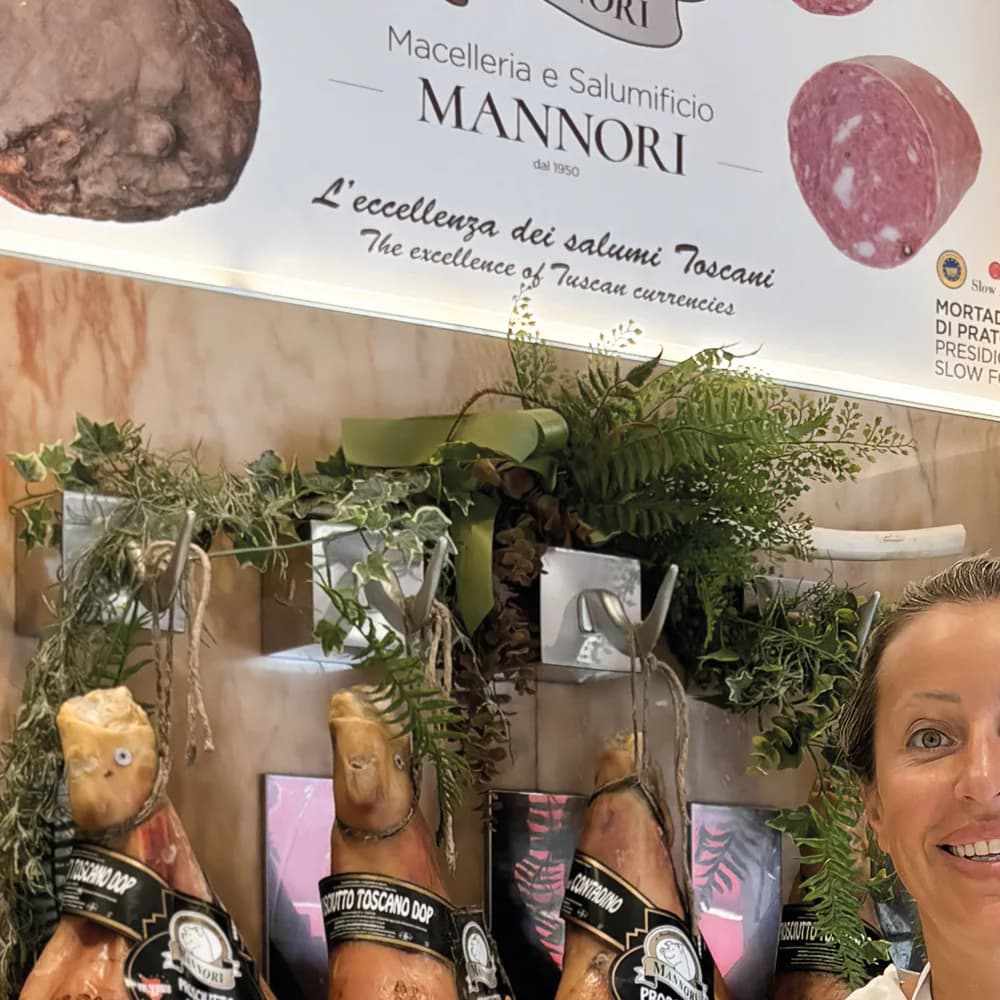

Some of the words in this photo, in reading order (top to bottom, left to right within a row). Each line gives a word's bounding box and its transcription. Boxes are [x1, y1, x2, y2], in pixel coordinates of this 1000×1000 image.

[388, 24, 532, 83] Macelleria
[542, 68, 559, 88] e
[569, 67, 715, 123] Salumificio
[417, 77, 687, 176] MANNORI
[533, 158, 550, 174] dal
[553, 161, 580, 178] 1950
[312, 176, 499, 241] L'eccellenza
[511, 217, 555, 247] dei
[564, 231, 662, 268] salumi
[674, 243, 776, 290] Toscani
[360, 228, 403, 258] The
[409, 243, 516, 277] excellence
[521, 262, 547, 288] of
[550, 263, 627, 297] Tuscan
[632, 286, 736, 317] currencies
[971, 278, 997, 294] Slow
[936, 319, 952, 336] DI
[935, 360, 983, 382] SLOW
[110, 872, 137, 895] DOP
[571, 872, 625, 915] CONTADINO
[357, 888, 411, 917] TOSCANO
[411, 904, 435, 925] DOP
